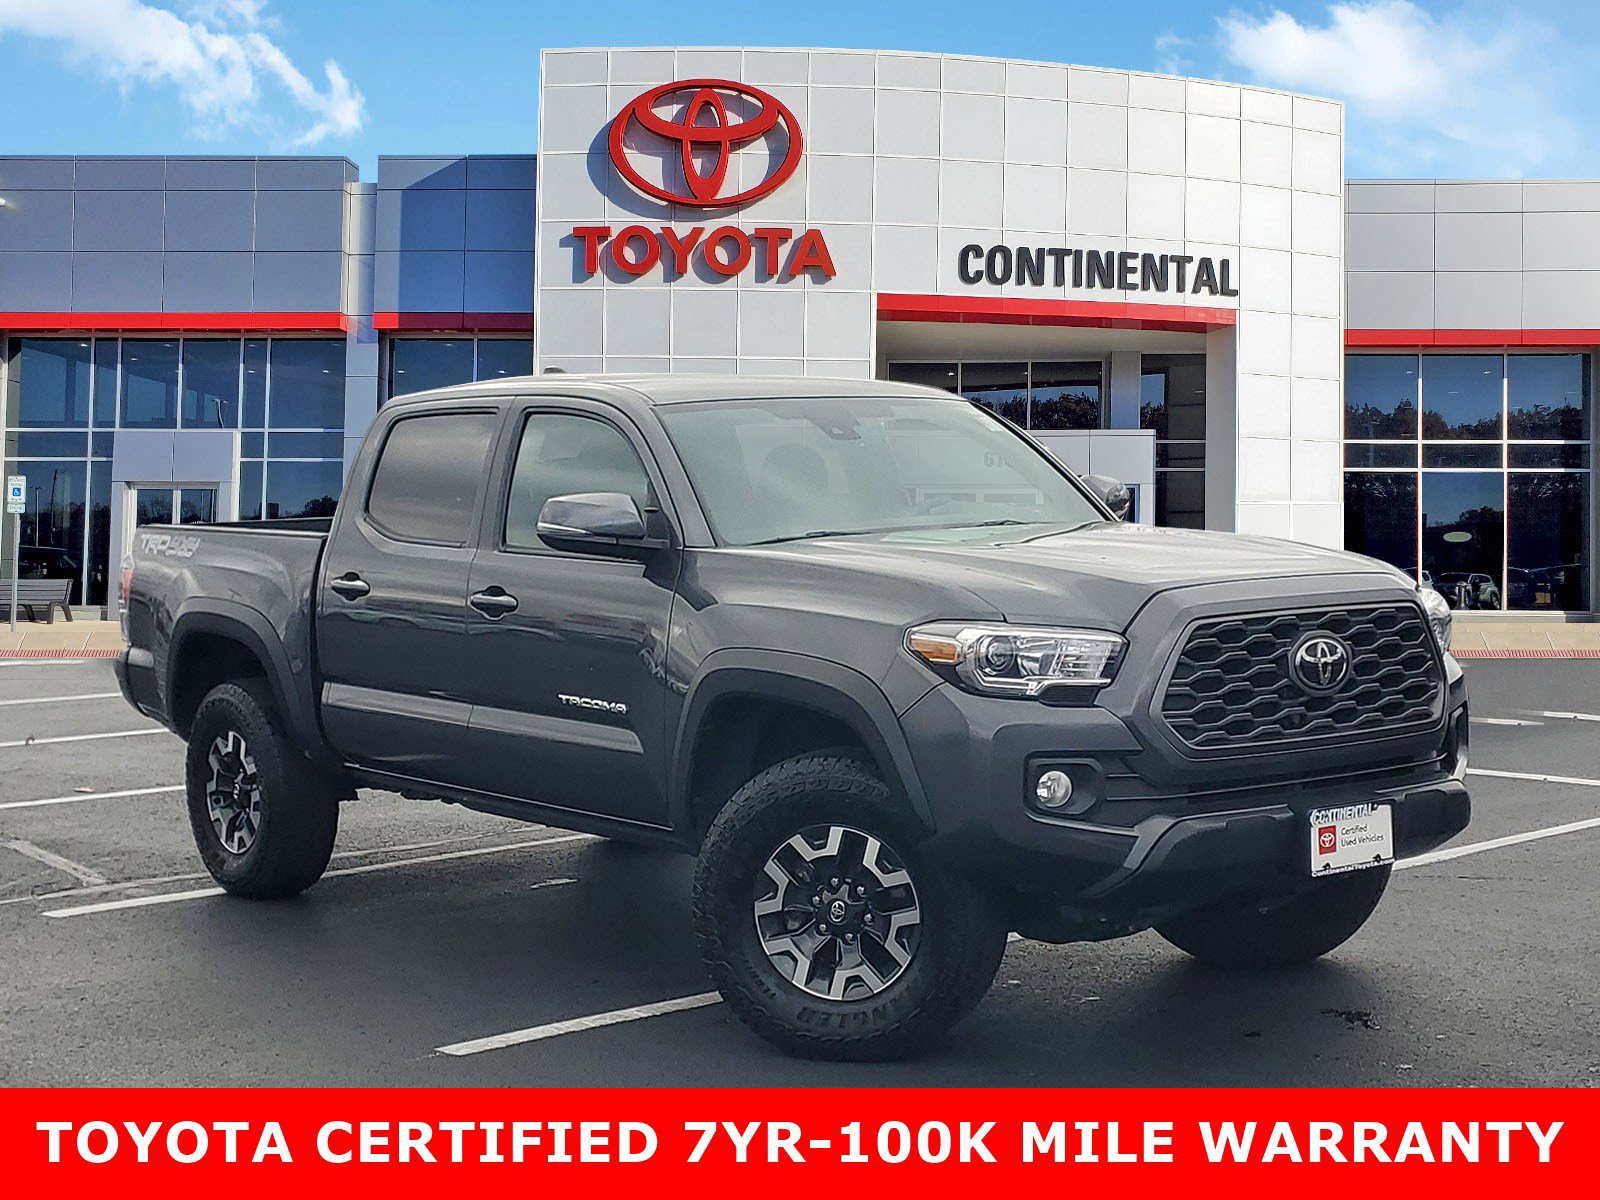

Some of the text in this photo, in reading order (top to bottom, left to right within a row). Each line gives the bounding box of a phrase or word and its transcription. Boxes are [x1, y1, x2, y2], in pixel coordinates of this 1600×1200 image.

[572, 225, 837, 278] TOYOTA
[958, 244, 1239, 297] CONTINENTAL
[558, 694, 627, 715] TACOMA
[1310, 802, 1373, 826] CONTINENTAL
[1340, 824, 1368, 836] Certified
[1340, 834, 1385, 847] Used Vehicles
[1311, 858, 1396, 877] ContinentalToyota.com
